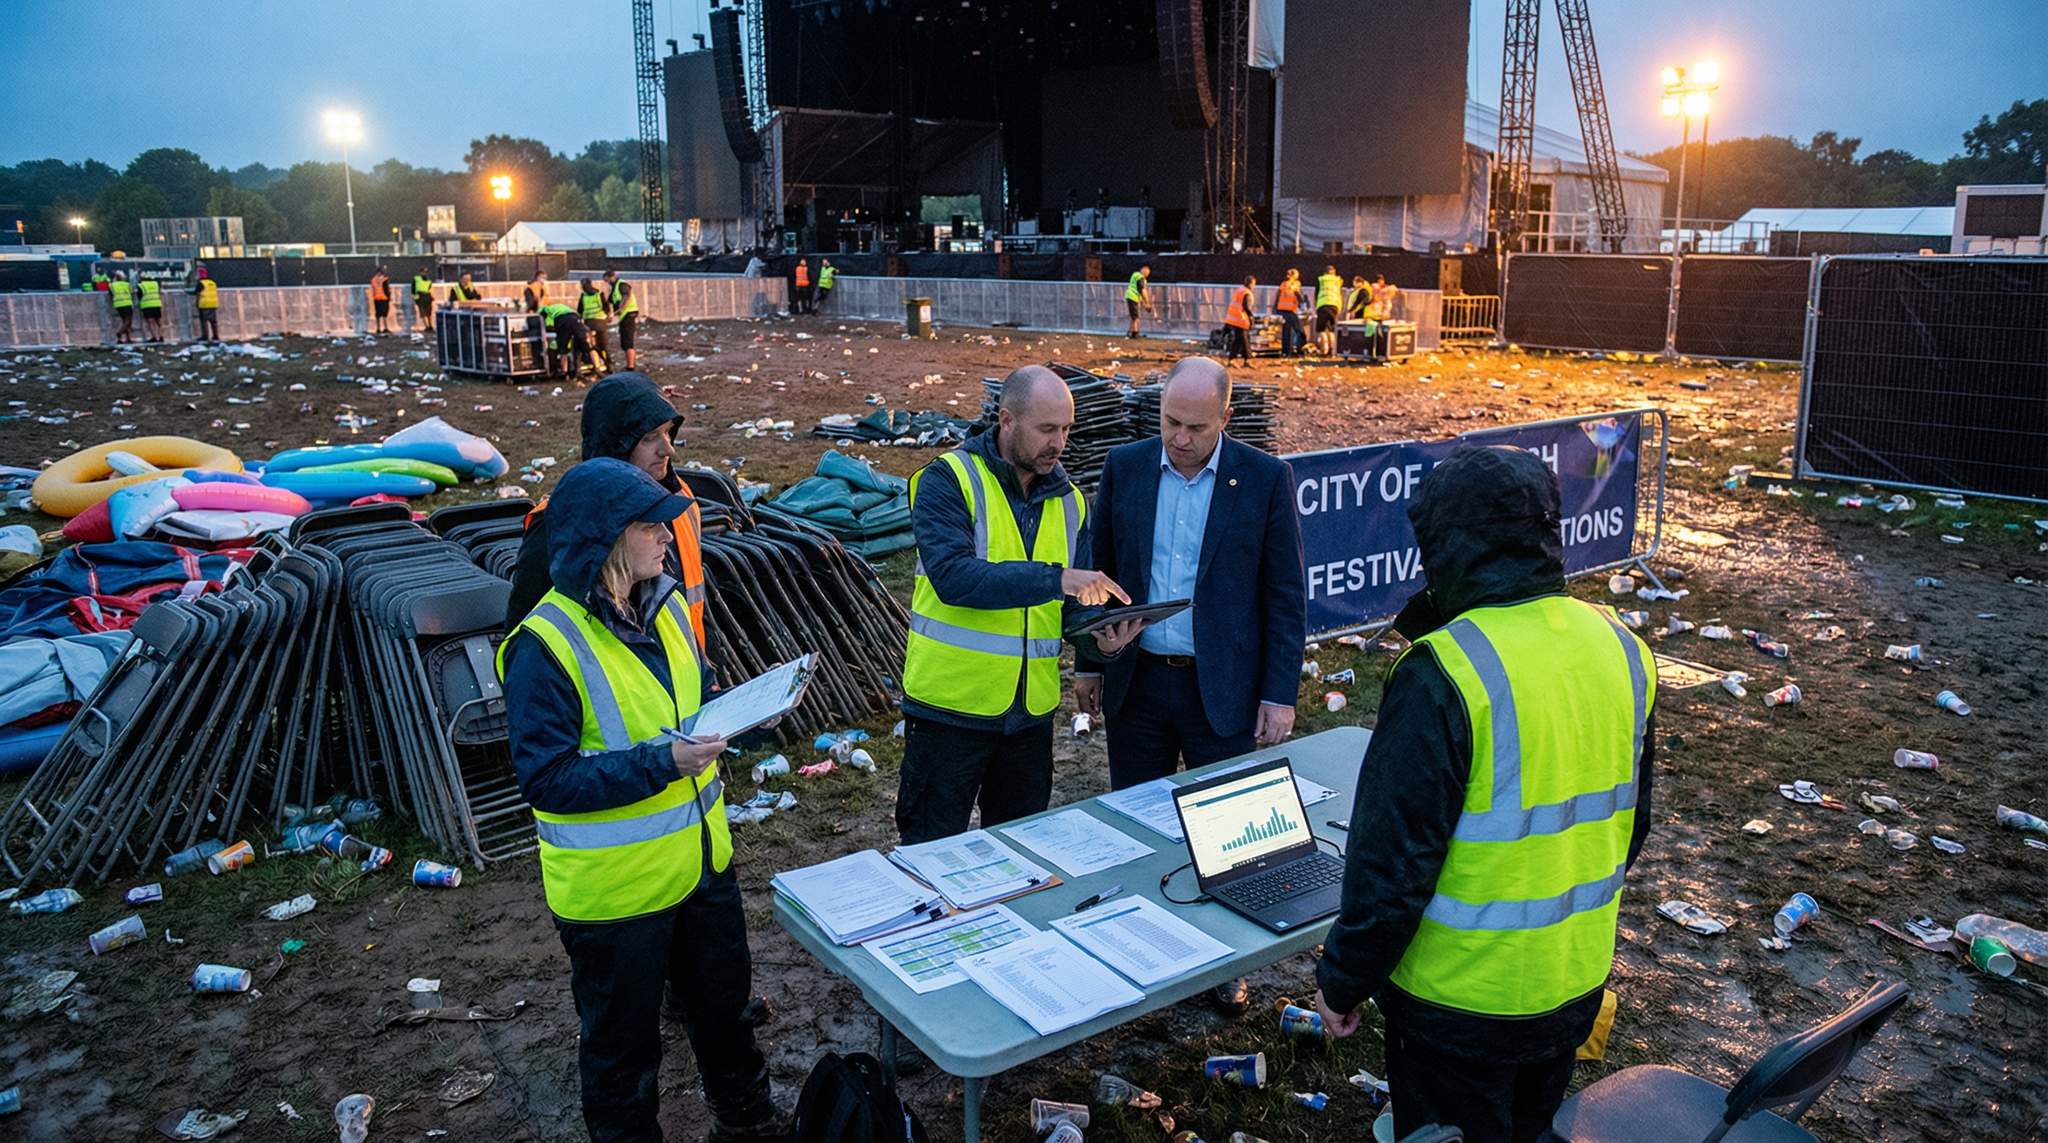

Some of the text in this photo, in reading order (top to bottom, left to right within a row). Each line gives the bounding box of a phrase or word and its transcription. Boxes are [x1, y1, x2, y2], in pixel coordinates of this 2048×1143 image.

[1296, 463, 1422, 516] CITY OF
[1308, 506, 1624, 600] FESTIVA TIONS
